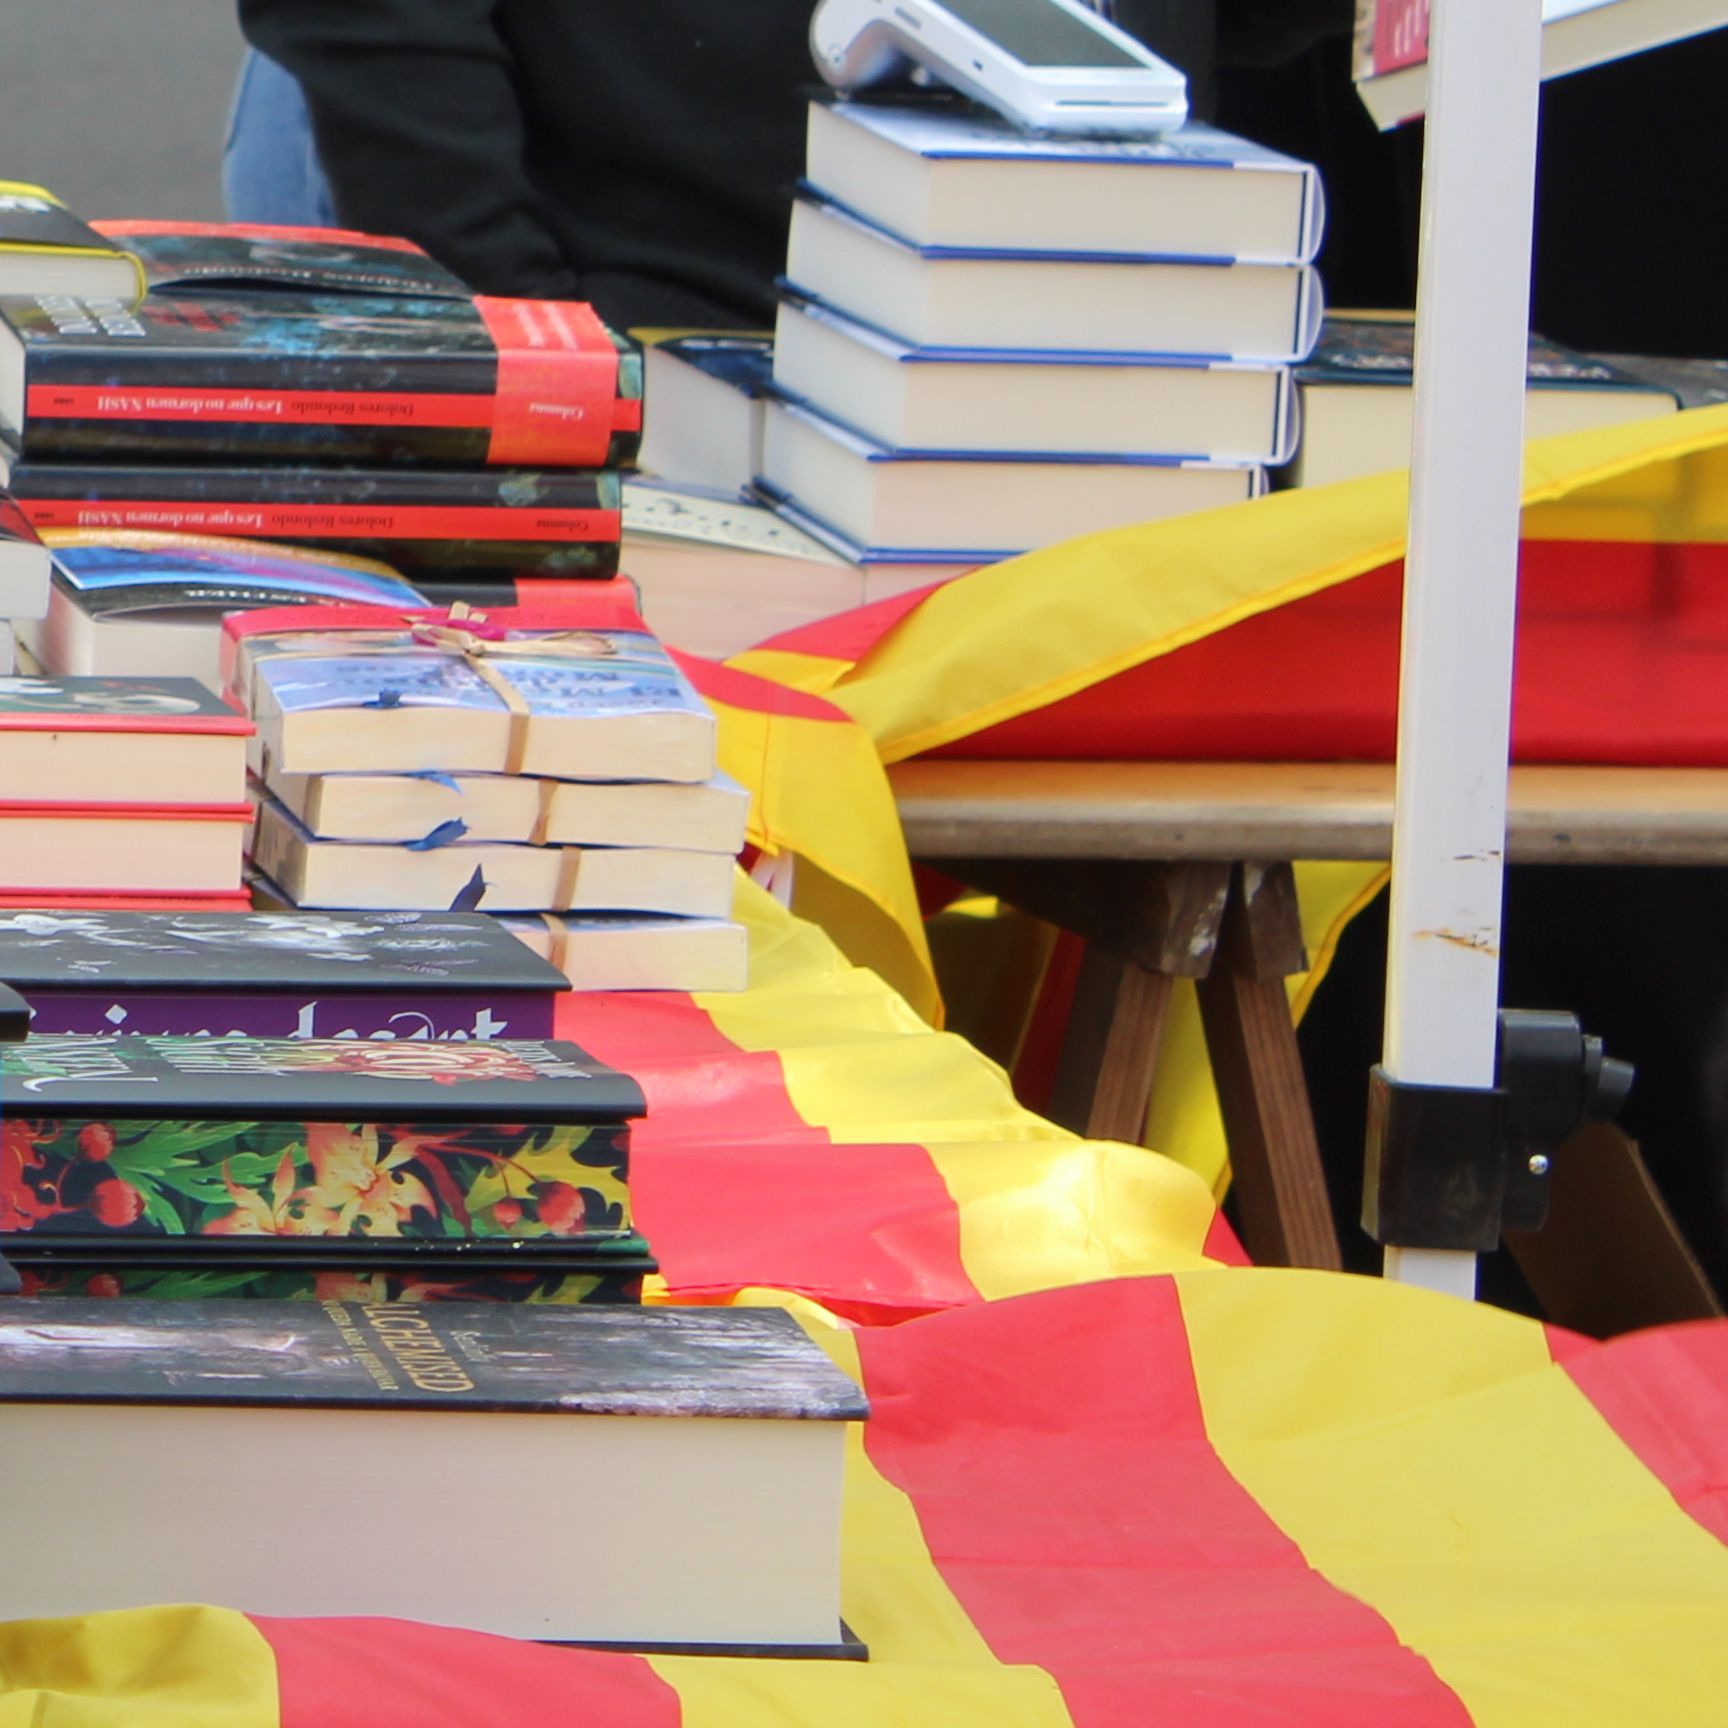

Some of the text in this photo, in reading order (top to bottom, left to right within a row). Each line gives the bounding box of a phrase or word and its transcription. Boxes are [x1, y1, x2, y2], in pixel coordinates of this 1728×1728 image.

[96, 394, 413, 418] Dolores Redondo Les que no dormen NASH
[528, 401, 583, 420] Columna
[76, 509, 393, 529] Dolores Redondo Les que no dormen NASH
[361, 1301, 475, 1393] ALCHEMISED
